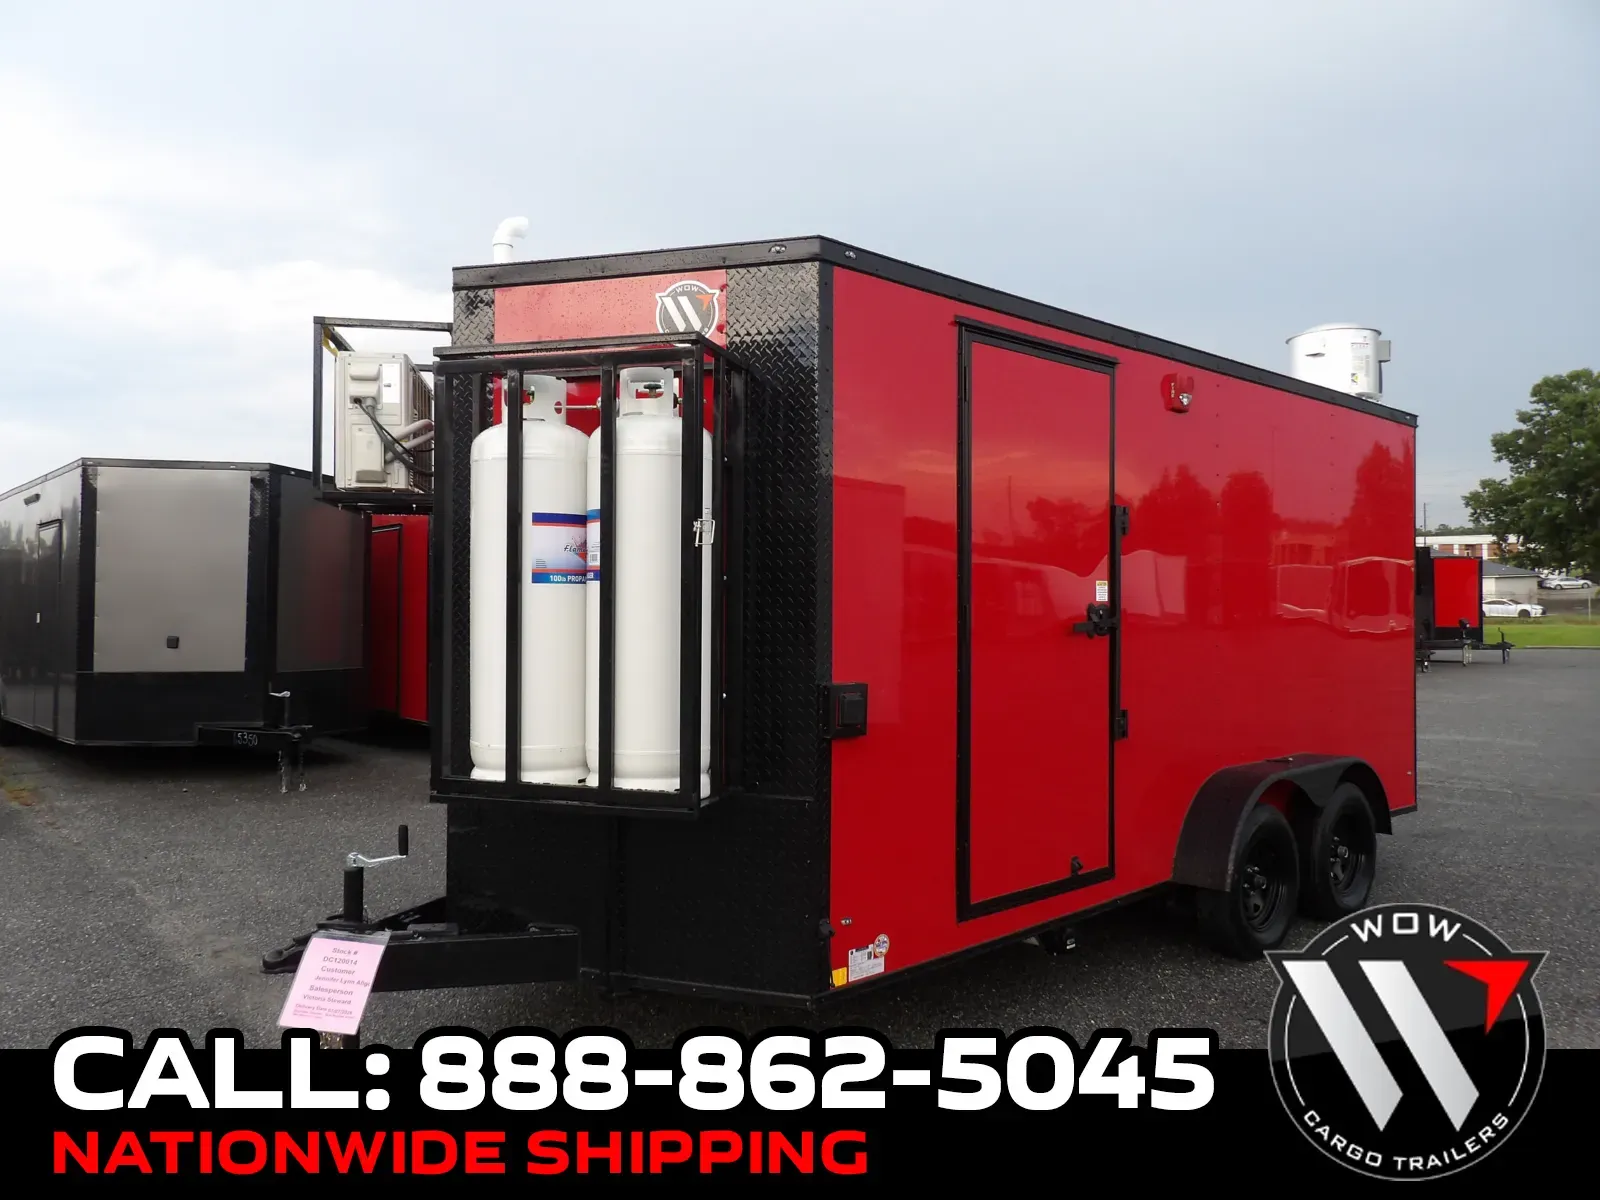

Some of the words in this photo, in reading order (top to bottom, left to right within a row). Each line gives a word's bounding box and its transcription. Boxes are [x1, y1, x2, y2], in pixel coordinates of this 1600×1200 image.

[675, 284, 699, 292] WOW
[321, 966, 355, 975] Customer
[314, 975, 339, 983] Jennifer
[340, 978, 355, 986] Lynn
[309, 985, 353, 996] Salesperson
[303, 994, 326, 1003] Victoria
